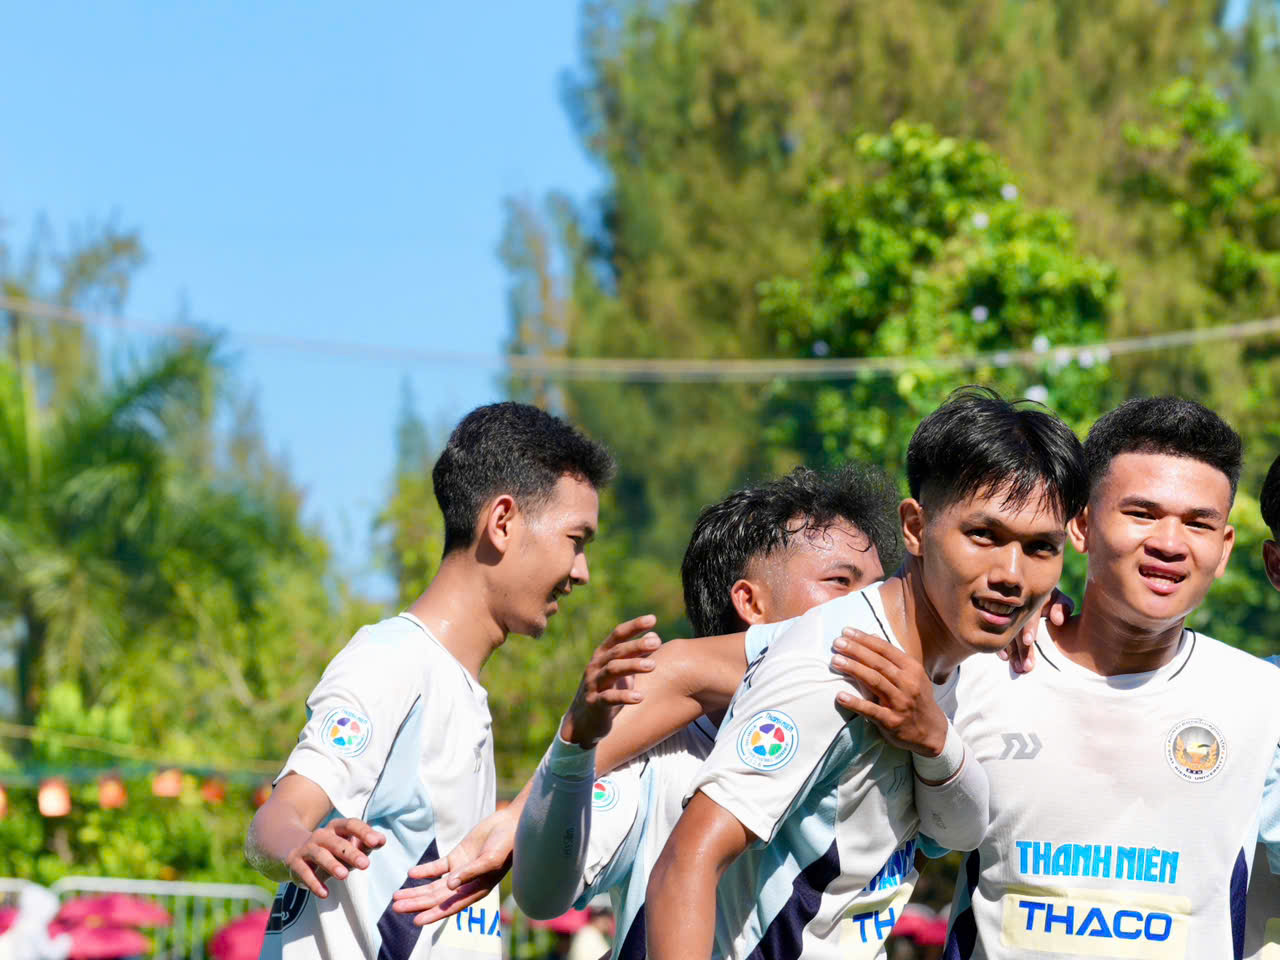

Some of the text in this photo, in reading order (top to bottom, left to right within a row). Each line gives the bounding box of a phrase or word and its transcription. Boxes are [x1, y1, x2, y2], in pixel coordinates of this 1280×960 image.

[1016, 840, 1180, 884] THANH NIÊN
[1019, 900, 1173, 942] THACO
